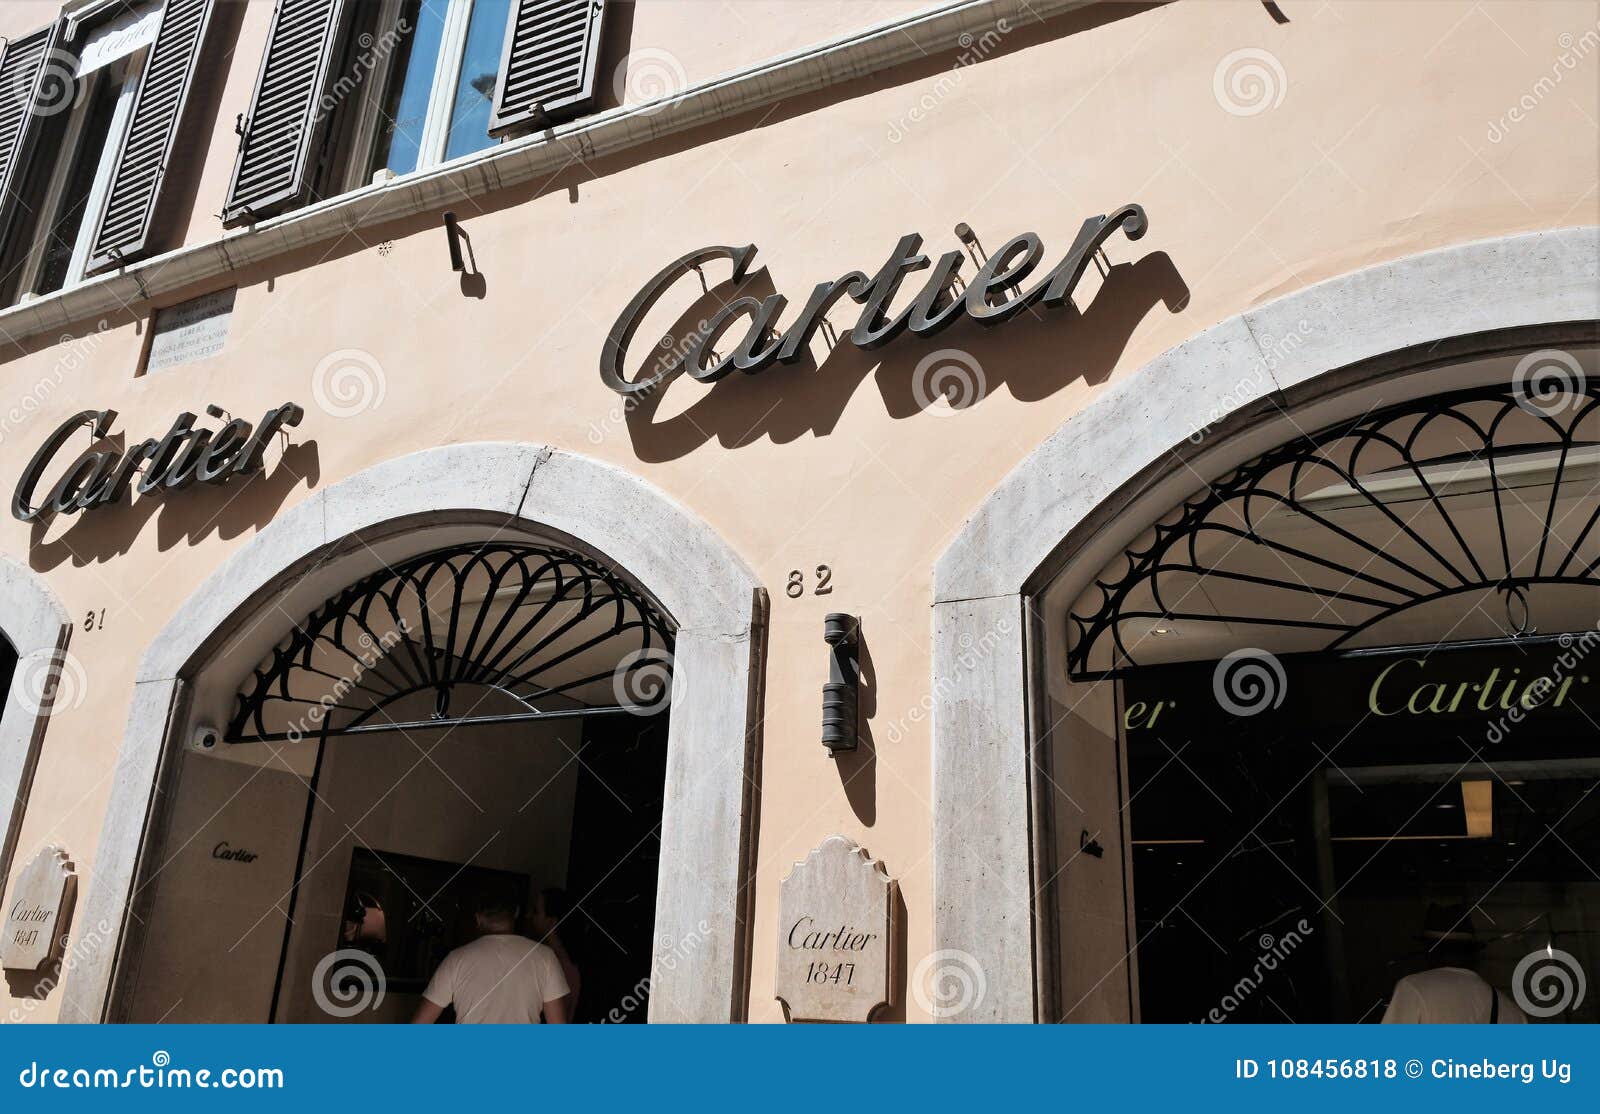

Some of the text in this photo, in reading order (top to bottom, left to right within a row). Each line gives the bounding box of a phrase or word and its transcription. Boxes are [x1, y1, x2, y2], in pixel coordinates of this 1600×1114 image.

[599, 203, 1149, 393] Cartier
[11, 402, 304, 522] Cartier
[786, 564, 832, 598] 82
[84, 607, 106, 632] 81
[1369, 658, 1590, 715] Cartier
[212, 841, 259, 863] Cartier
[10, 898, 53, 922] Cartier
[13, 930, 39, 946] 1847
[788, 916, 877, 950] Cartier
[806, 962, 855, 985] 1847
